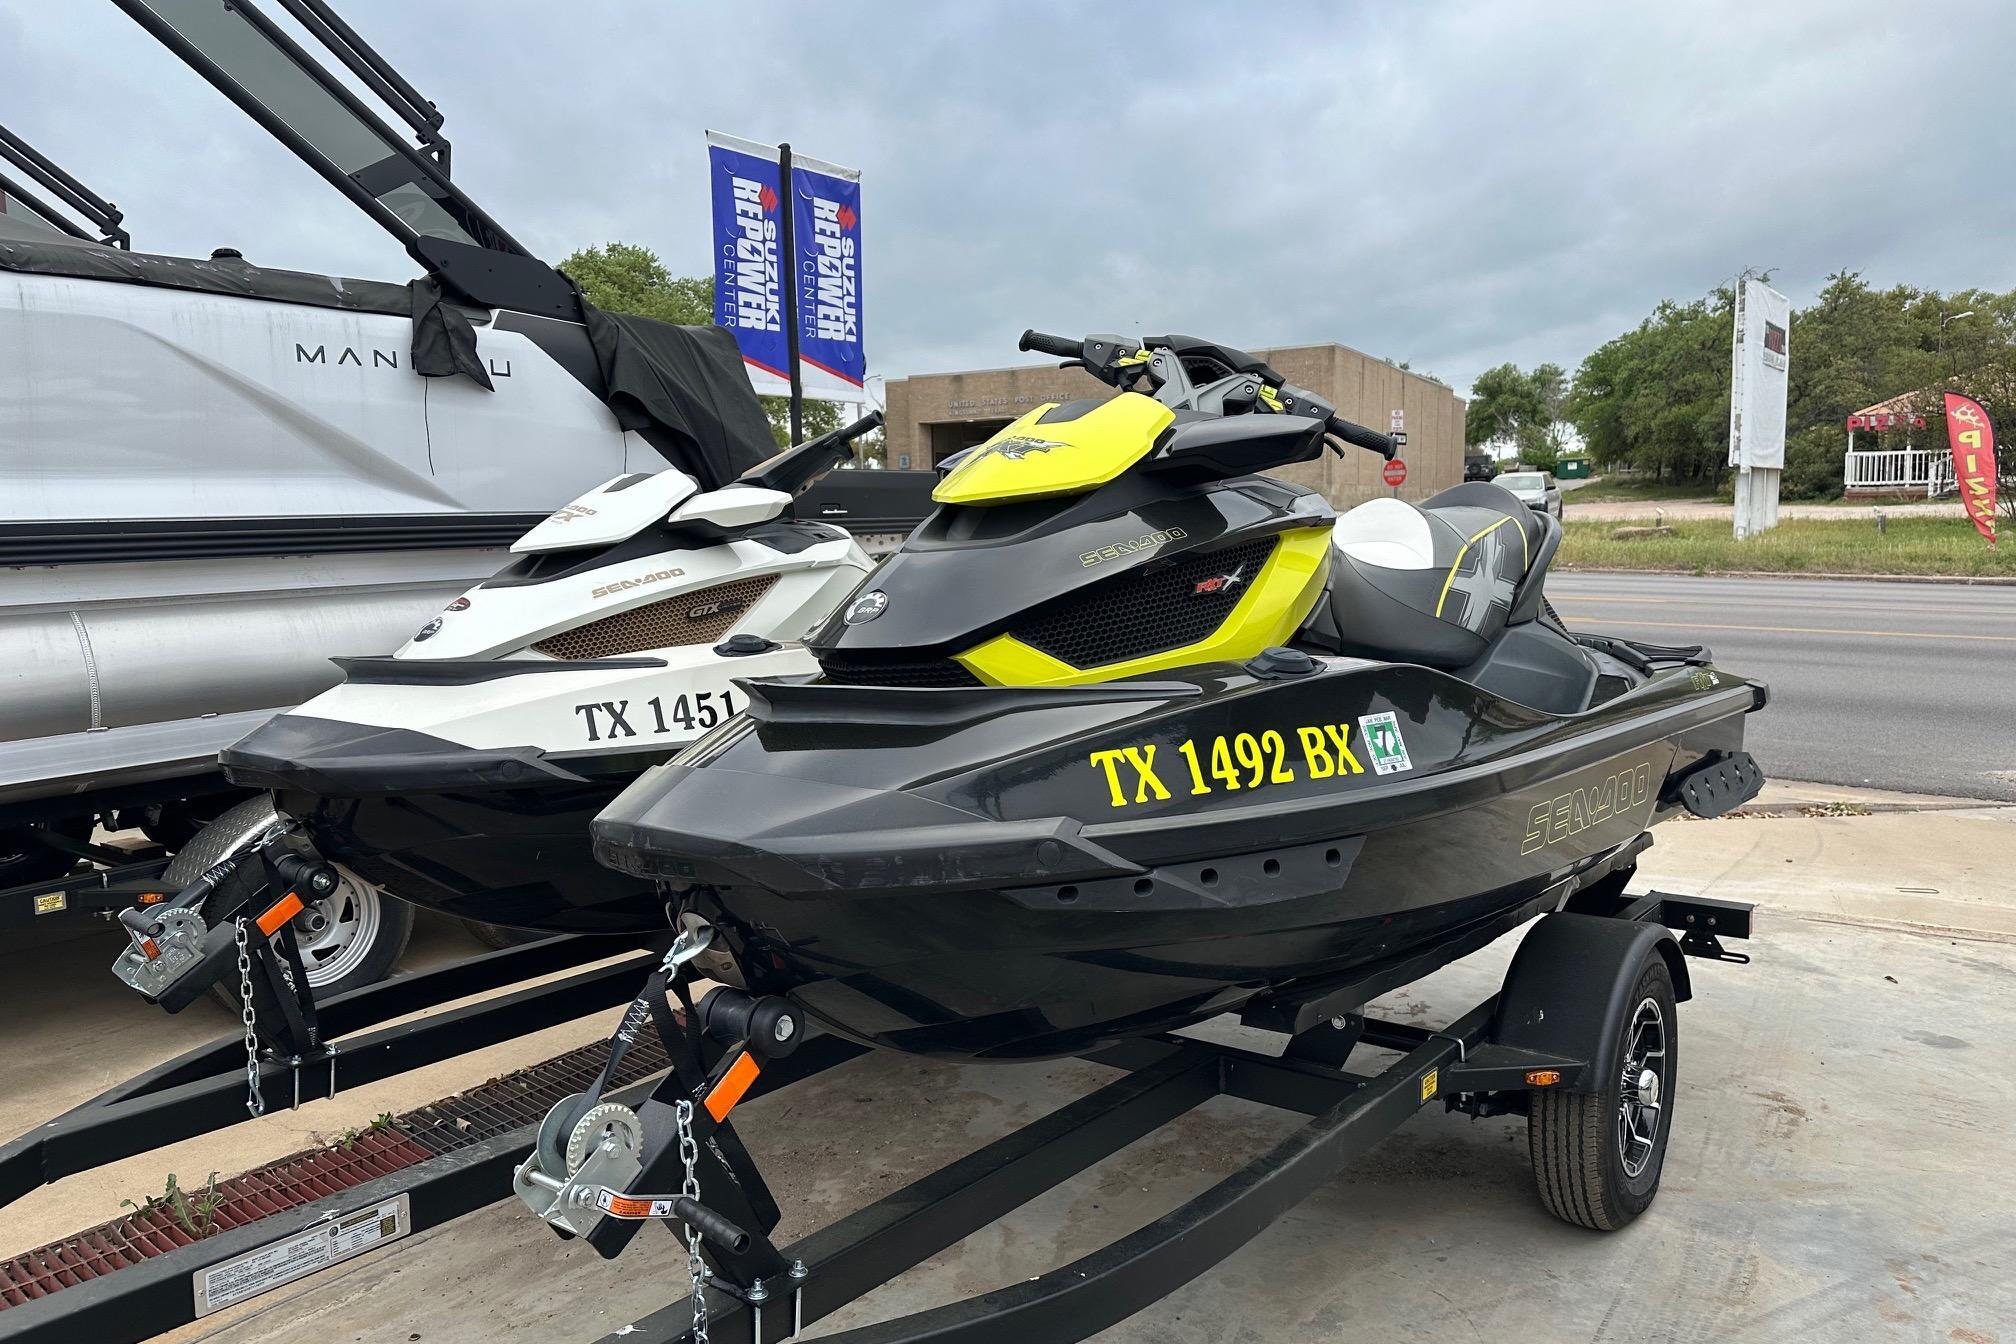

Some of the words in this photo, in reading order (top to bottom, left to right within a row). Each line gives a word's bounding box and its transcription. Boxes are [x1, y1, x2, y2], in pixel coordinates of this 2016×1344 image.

[723, 244, 737, 328] CENTER
[732, 176, 765, 331] REPOWER
[763, 218, 780, 332] SUZUKI
[813, 196, 845, 342] REPOWER
[840, 236, 857, 343] SUZUKI
[803, 260, 816, 338] CENTER
[295, 343, 511, 378] MANIU
[948, 400, 976, 408] UNITED
[982, 398, 1008, 406] STATES
[1014, 396, 1034, 404] POST
[1040, 393, 1070, 401] OFFICE
[688, 601, 721, 618] GTX
[575, 699, 636, 741] TX
[648, 690, 736, 734] 1451
[1374, 724, 1390, 757] 7
[1090, 744, 1171, 807] TX
[1178, 729, 1294, 795] 1492
[1297, 723, 1365, 779] BX
